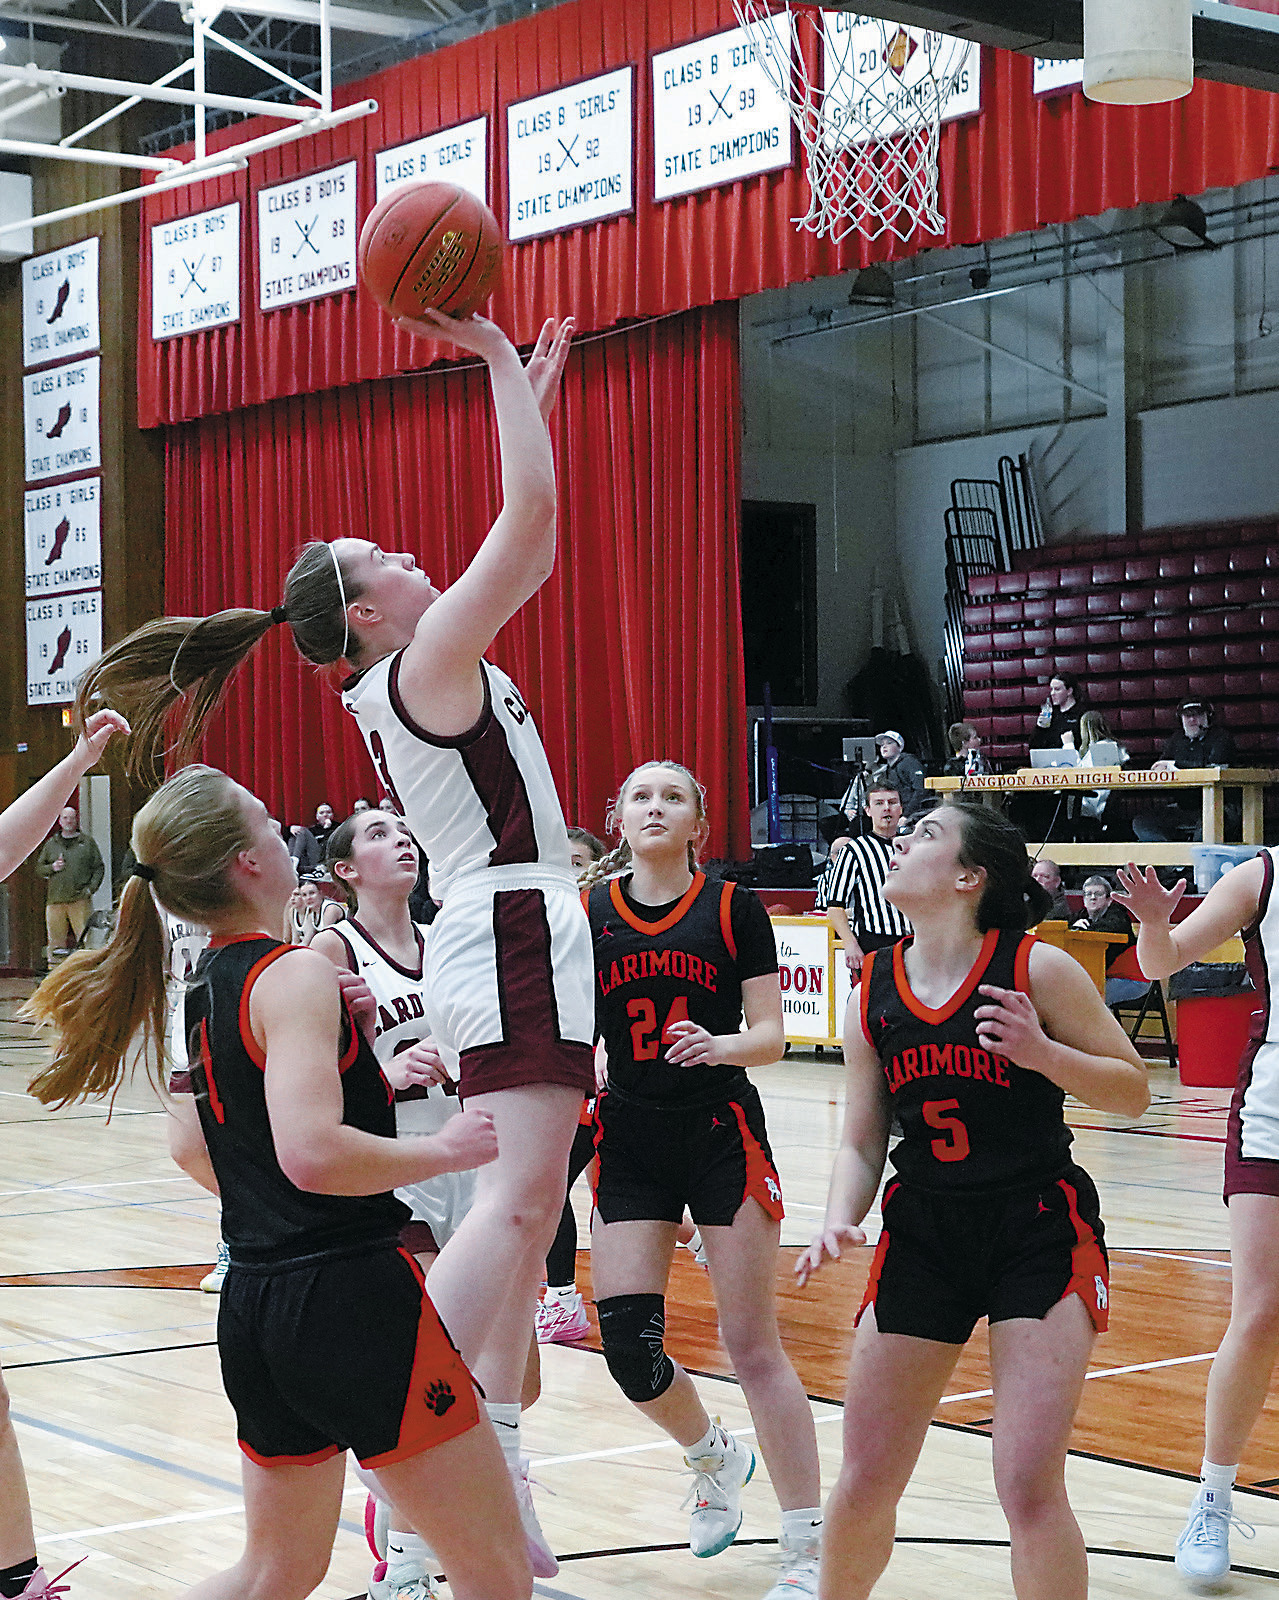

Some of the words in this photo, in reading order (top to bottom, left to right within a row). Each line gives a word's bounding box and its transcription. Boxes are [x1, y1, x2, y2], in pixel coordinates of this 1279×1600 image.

[836, 12, 877, 33] CLA
[664, 60, 702, 90] CLASS
[711, 54, 719, 75] B
[859, 50, 877, 74] 20
[517, 111, 551, 138] CLASS
[558, 106, 565, 126] B
[688, 104, 702, 127] 19
[739, 88, 755, 111] 99
[538, 152, 551, 174] 19
[586, 138, 600, 159] 92
[665, 148, 702, 178] STATE
[710, 126, 779, 165] CHAMPIONS
[385, 158, 414, 184] CLASS
[420, 154, 427, 172] B
[269, 190, 299, 213] CLASS
[305, 186, 311, 203] B
[517, 193, 551, 221] STATE
[558, 173, 622, 209] CHAMPIONS
[164, 224, 188, 245] CLASS
[272, 236, 280, 254] 19
[266, 276, 293, 299] STATE
[299, 261, 350, 291] CHAMPIONS
[163, 311, 183, 330] STATE
[190, 301, 230, 324] CHAMPIONS
[27, 495, 51, 512] CLASS
[27, 573, 49, 589] STATE
[54, 565, 100, 586] CHAMPIONS
[28, 605, 53, 621] CLASS
[29, 682, 51, 697] STATE
[959, 775, 1027, 788] LANGDON
[1032, 774, 1070, 786] AREA
[1075, 772, 1113, 785] HIGH
[1118, 770, 1179, 784] SCHOOL
[598, 950, 718, 997] LARIMORE
[778, 965, 824, 995] DON
[784, 999, 820, 1016] HOOL
[626, 996, 690, 1062] 24
[884, 1043, 1011, 1094] LARIMORE
[922, 1098, 970, 1163] 5
